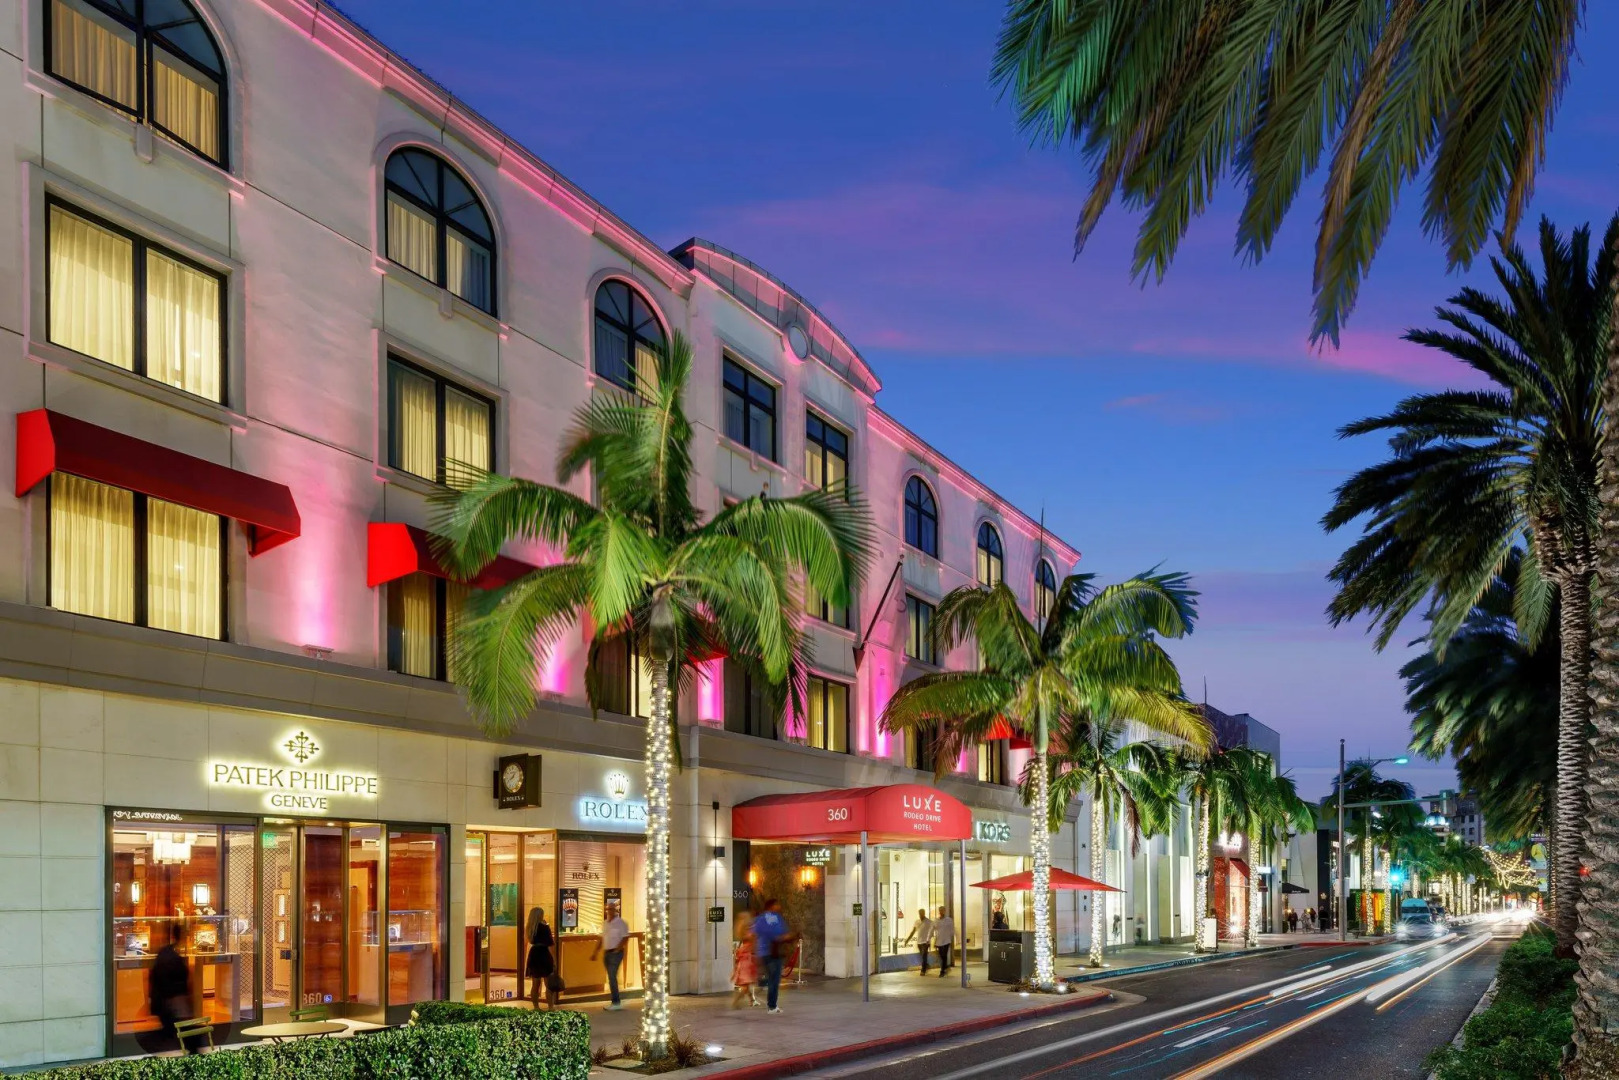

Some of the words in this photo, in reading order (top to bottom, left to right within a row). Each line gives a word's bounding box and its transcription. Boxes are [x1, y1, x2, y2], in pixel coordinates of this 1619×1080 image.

[214, 763, 284, 788] PATEK
[289, 770, 378, 794] PHILIPPE
[271, 794, 328, 810] GENEVE
[903, 794, 942, 812] LUXE
[827, 807, 848, 822] 360
[904, 811, 924, 820] RODEO
[925, 814, 942, 823] DRIVE
[913, 823, 933, 832] HOTEL
[980, 822, 1011, 842] KORS
[806, 848, 831, 858] LUXE
[572, 872, 600, 880] ROLEX
[733, 890, 748, 899] 360
[490, 989, 505, 1000] 360
